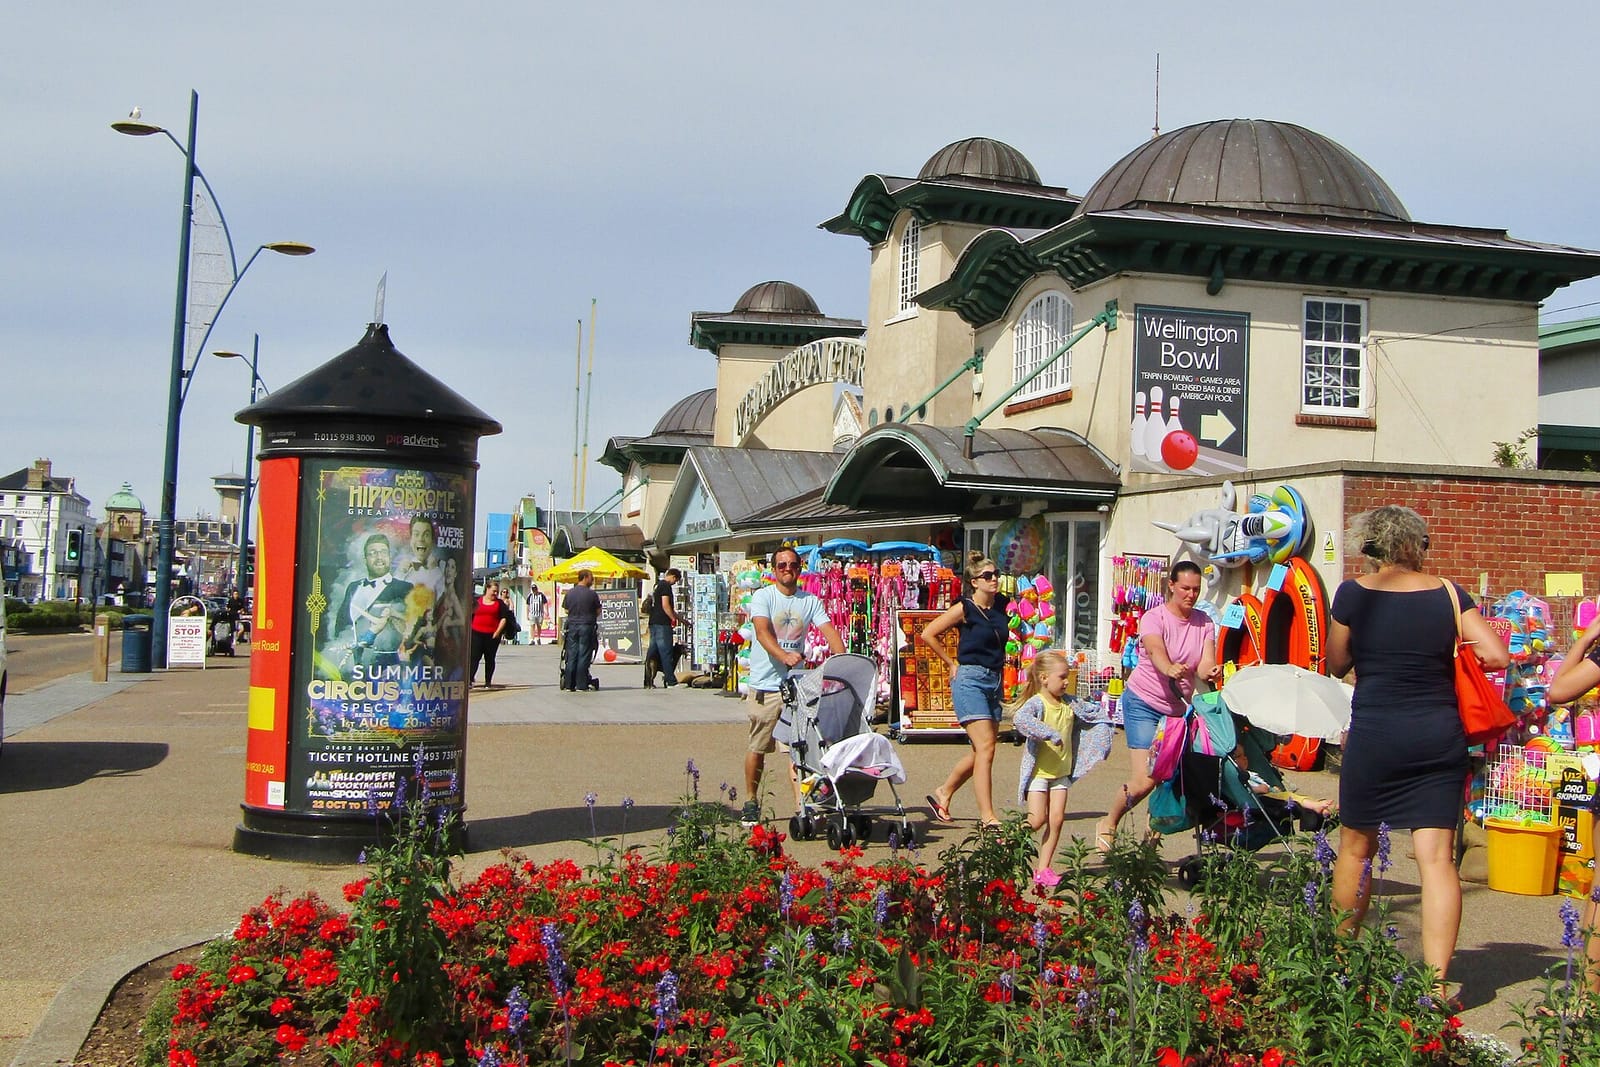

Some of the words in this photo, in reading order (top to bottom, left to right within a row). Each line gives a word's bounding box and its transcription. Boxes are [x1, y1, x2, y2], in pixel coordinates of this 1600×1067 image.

[1143, 316, 1238, 347] Wellington
[1160, 342, 1220, 370] Bowl
[827, 341, 866, 387] PIER
[1141, 371, 1163, 380] TENPIN
[1163, 373, 1194, 382] BOWLING
[1200, 376, 1223, 385] GAMES
[1224, 378, 1241, 386] AREA
[1172, 383, 1202, 391] LICENSED
[1202, 384, 1216, 392] BAR
[1222, 386, 1241, 395] DINER
[1180, 392, 1214, 401] AMERICAN
[1215, 394, 1233, 403] POOL
[340, 433, 355, 441] 938
[356, 433, 375, 442] 3000
[349, 485, 455, 512] HIPPODROME
[348, 508, 390, 516] GREAT
[399, 510, 455, 519] YARMOUTH
[438, 526, 464, 538] WE'RE
[437, 536, 464, 549] BACK!
[1299, 584, 1313, 606] PRO
[600, 600, 634, 610] ellington
[602, 608, 627, 620] Bowl
[1305, 607, 1317, 653] EXPLORER
[261, 640, 280, 652] Road
[352, 665, 444, 680] SUMMER
[307, 679, 400, 701] CIRCUS
[413, 681, 465, 700] WATER
[341, 703, 449, 713] SPECTACULAR
[340, 717, 355, 728] 1ST
[359, 717, 389, 728] AUG
[403, 717, 427, 728] 20TH
[430, 717, 452, 727] SEPT
[308, 752, 353, 762] TICKET
[356, 753, 409, 763] HOTLINE
[412, 752, 440, 762] 0493
[261, 764, 275, 774] 2AB
[329, 771, 396, 781] HALLOWEEN
[1563, 771, 1583, 782] V12
[332, 790, 370, 798] SPOOK
[1564, 784, 1584, 793] PRO
[1556, 792, 1593, 802] SKIMMER
[312, 800, 324, 809] 22
[325, 800, 347, 809] OCT
[1559, 815, 1577, 827] V12
